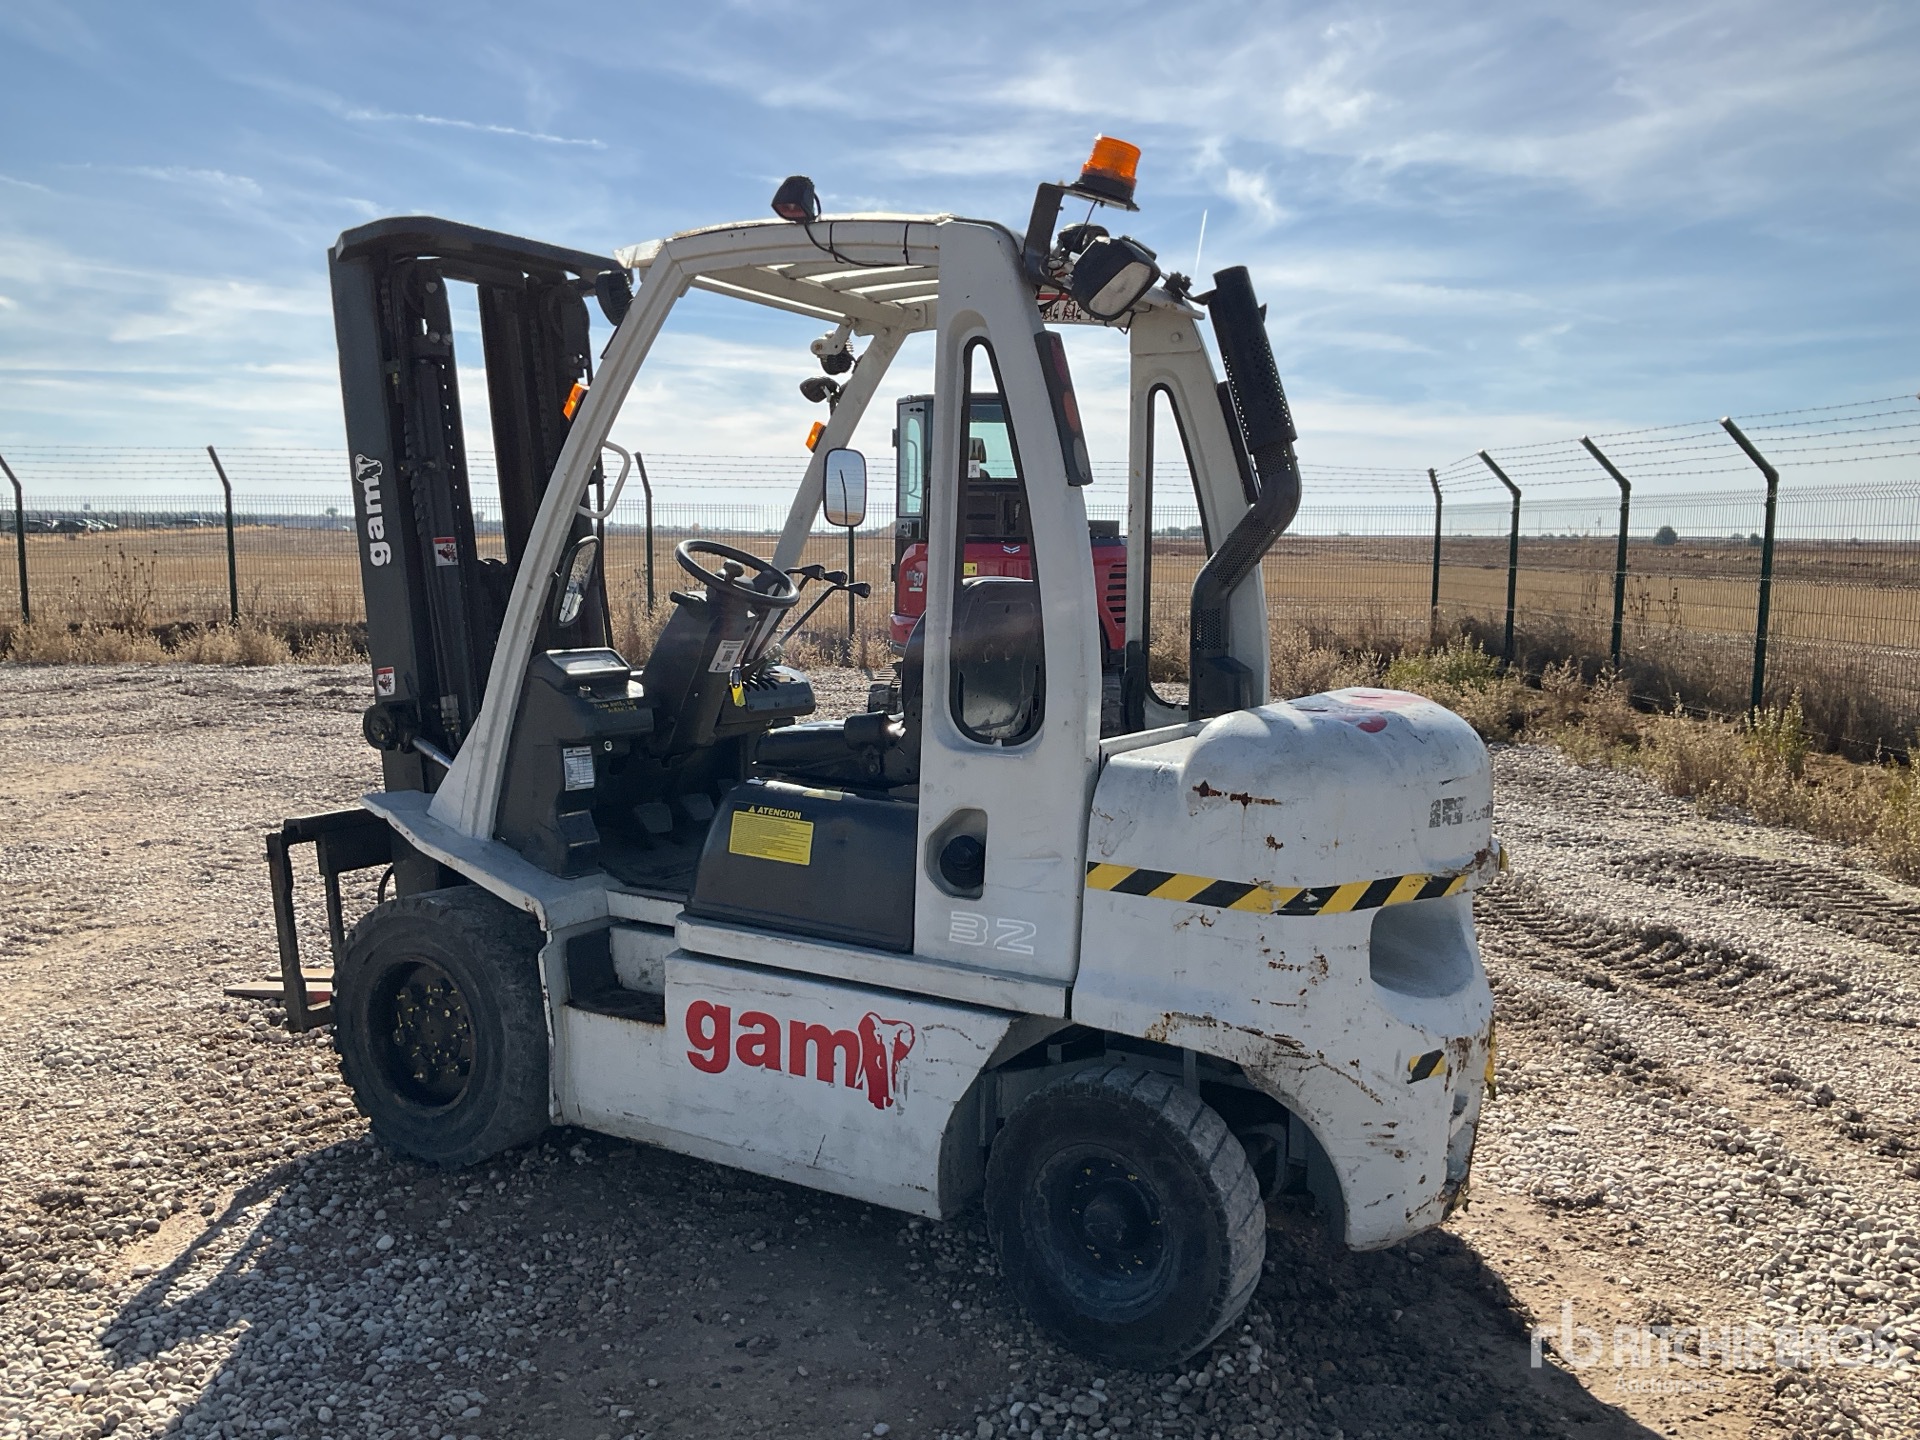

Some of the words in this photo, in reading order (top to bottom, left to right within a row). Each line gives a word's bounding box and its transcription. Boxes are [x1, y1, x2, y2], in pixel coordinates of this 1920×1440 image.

[364, 475, 392, 567] gam
[757, 806, 802, 820] ATENCION
[948, 911, 1037, 956] 32
[685, 999, 864, 1090] gam
